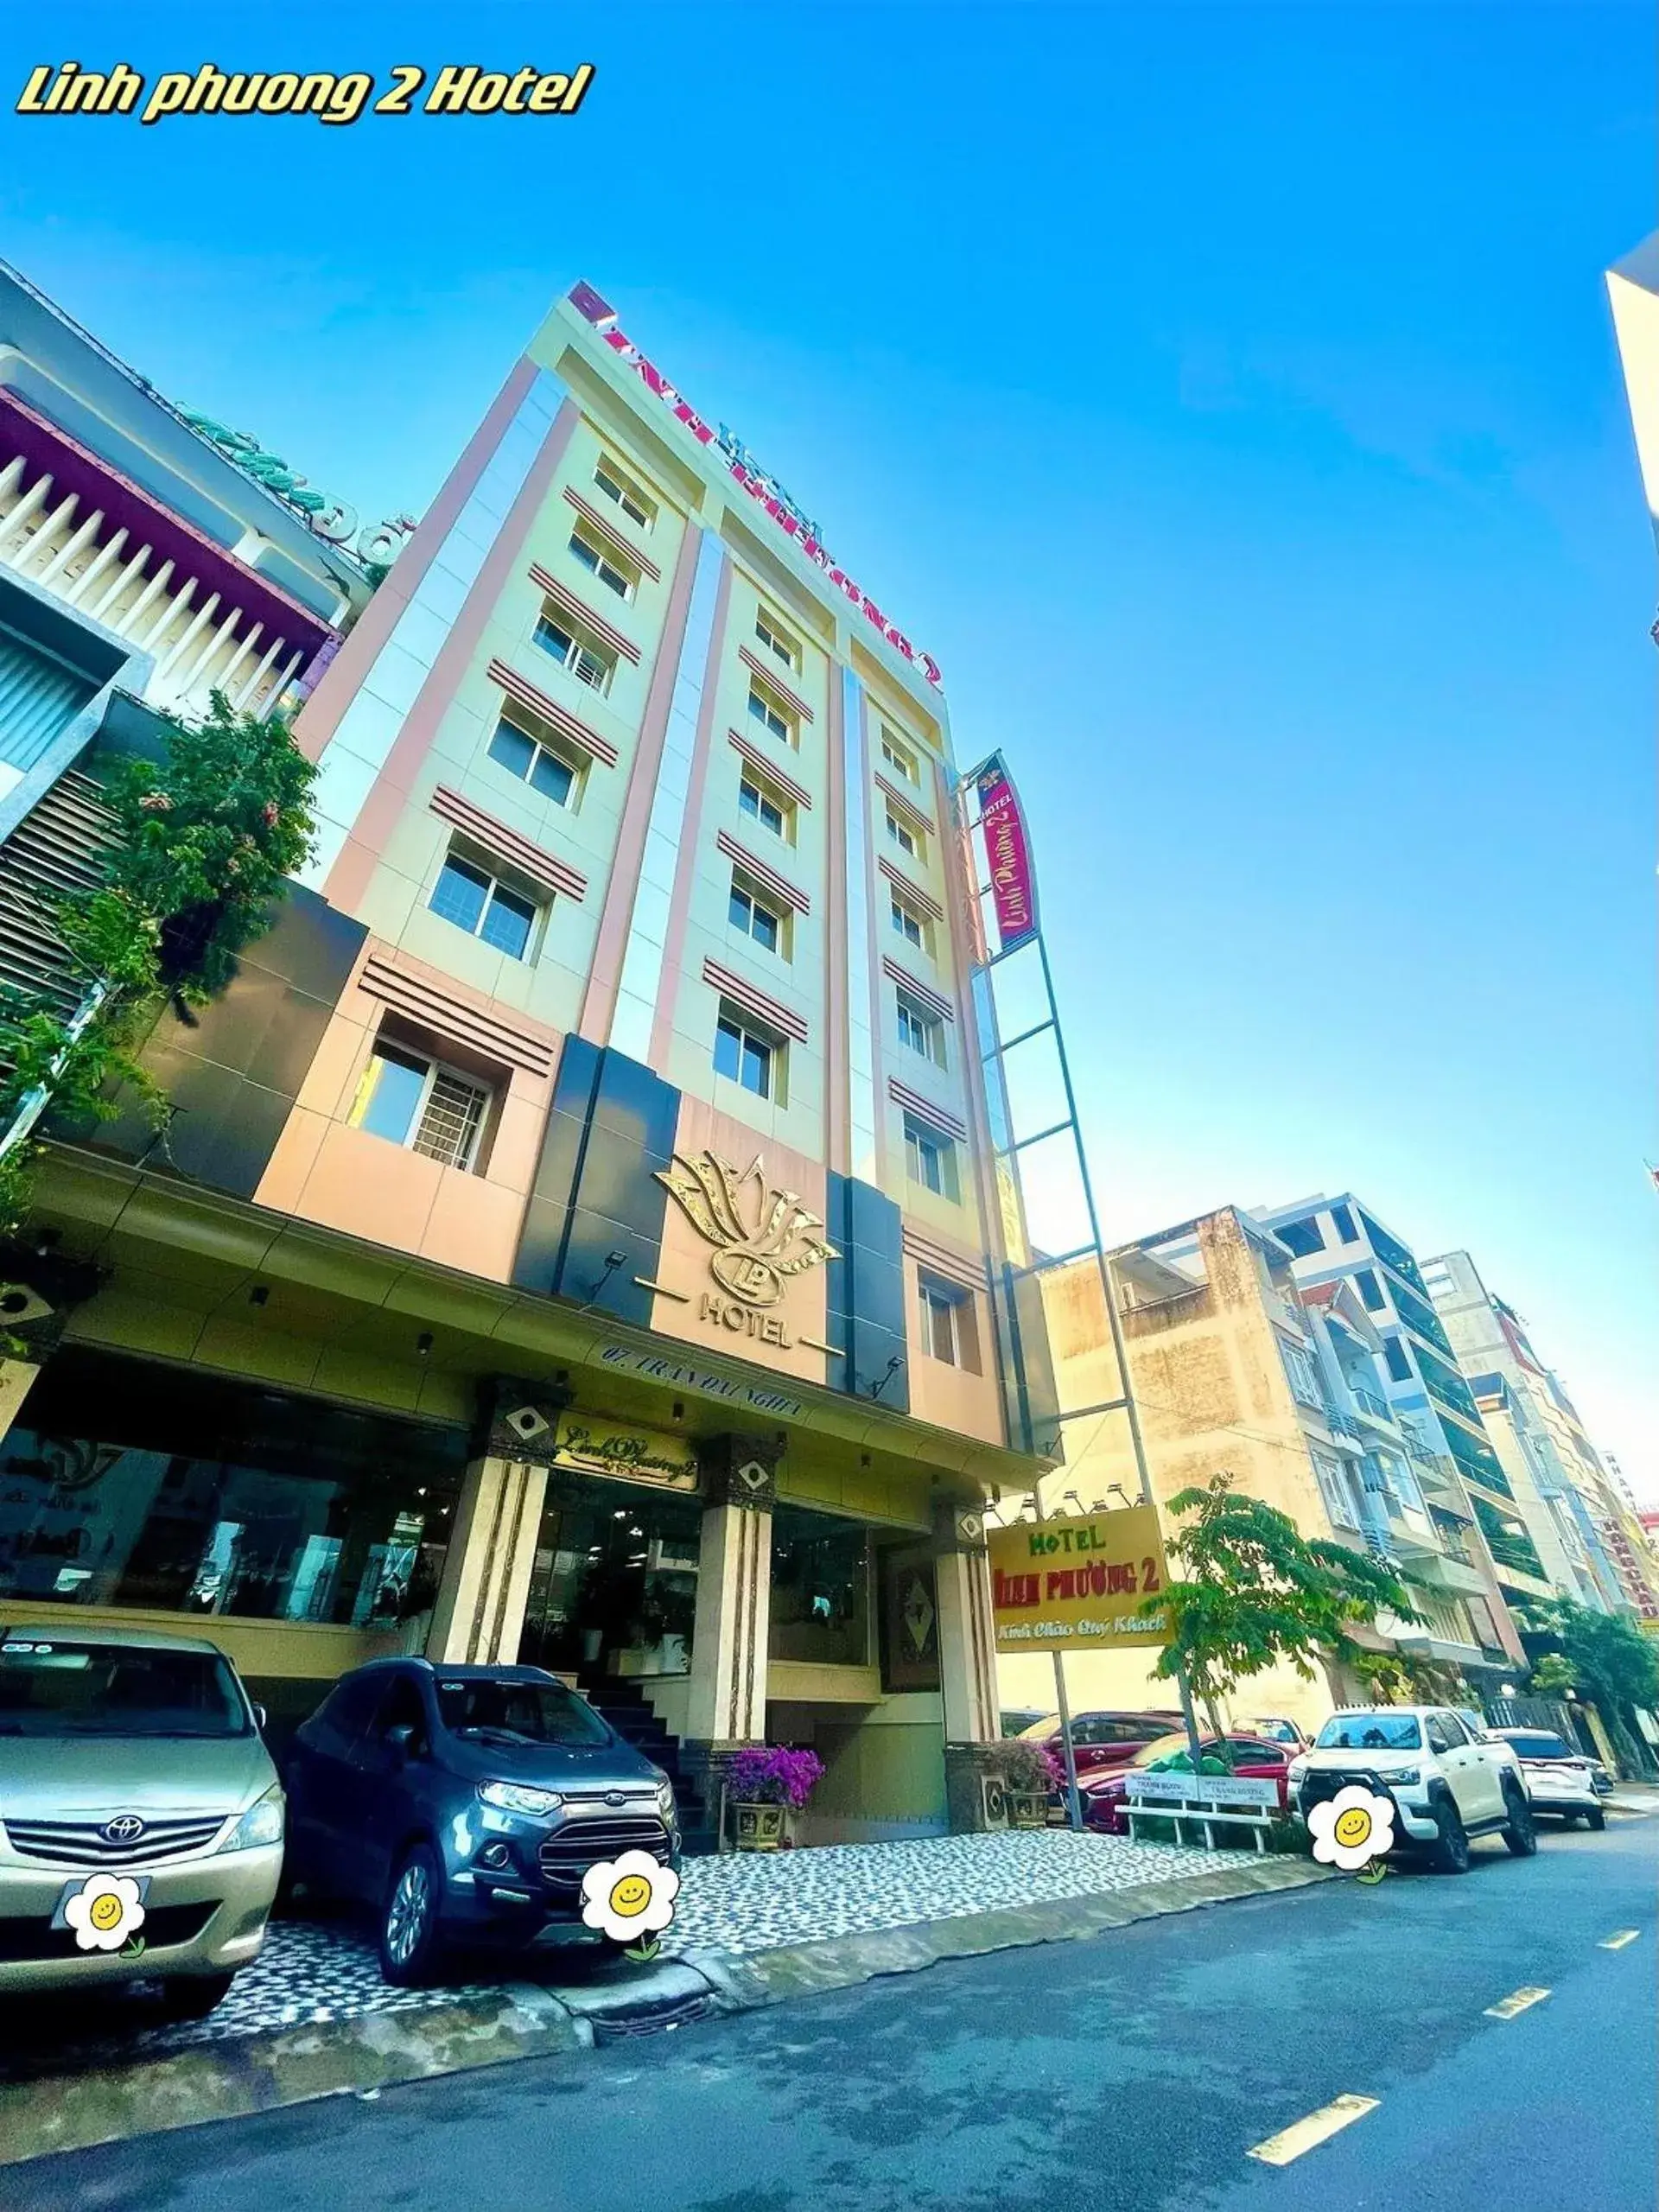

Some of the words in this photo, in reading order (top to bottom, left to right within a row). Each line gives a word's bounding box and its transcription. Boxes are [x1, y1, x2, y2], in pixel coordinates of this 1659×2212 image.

[980, 793, 1013, 823] HOTEL
[986, 810, 1009, 827] 2
[1000, 883, 1028, 928] Linh
[699, 1293, 792, 1349] HOTEL
[1029, 1524, 1107, 1557] HOTEL
[1141, 1556, 1160, 1592] 2
